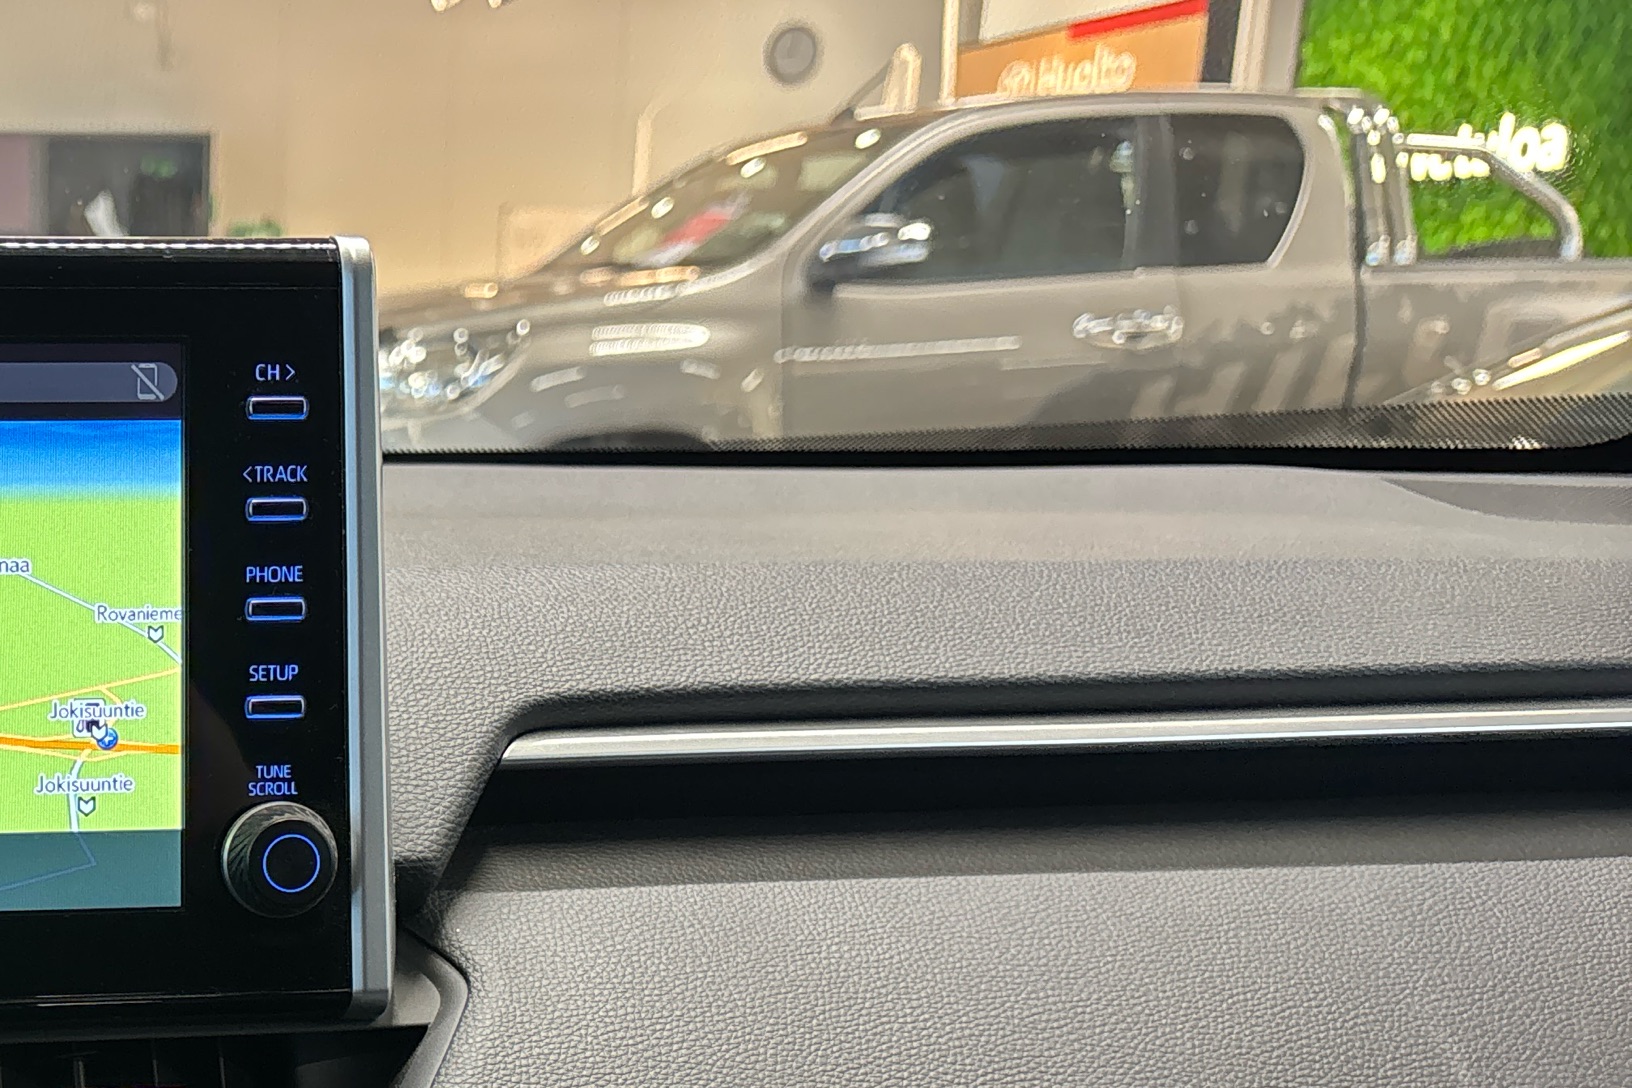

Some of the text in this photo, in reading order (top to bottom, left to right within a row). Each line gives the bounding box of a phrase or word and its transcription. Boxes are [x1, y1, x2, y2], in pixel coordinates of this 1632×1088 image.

[246, 565, 303, 583] PHONE
[249, 664, 299, 682] SETUP
[49, 702, 145, 719] Jokisuuntie
[255, 764, 292, 779] TUNE
[36, 775, 133, 793] Jokisuuntie
[248, 781, 298, 797] SCROLL
